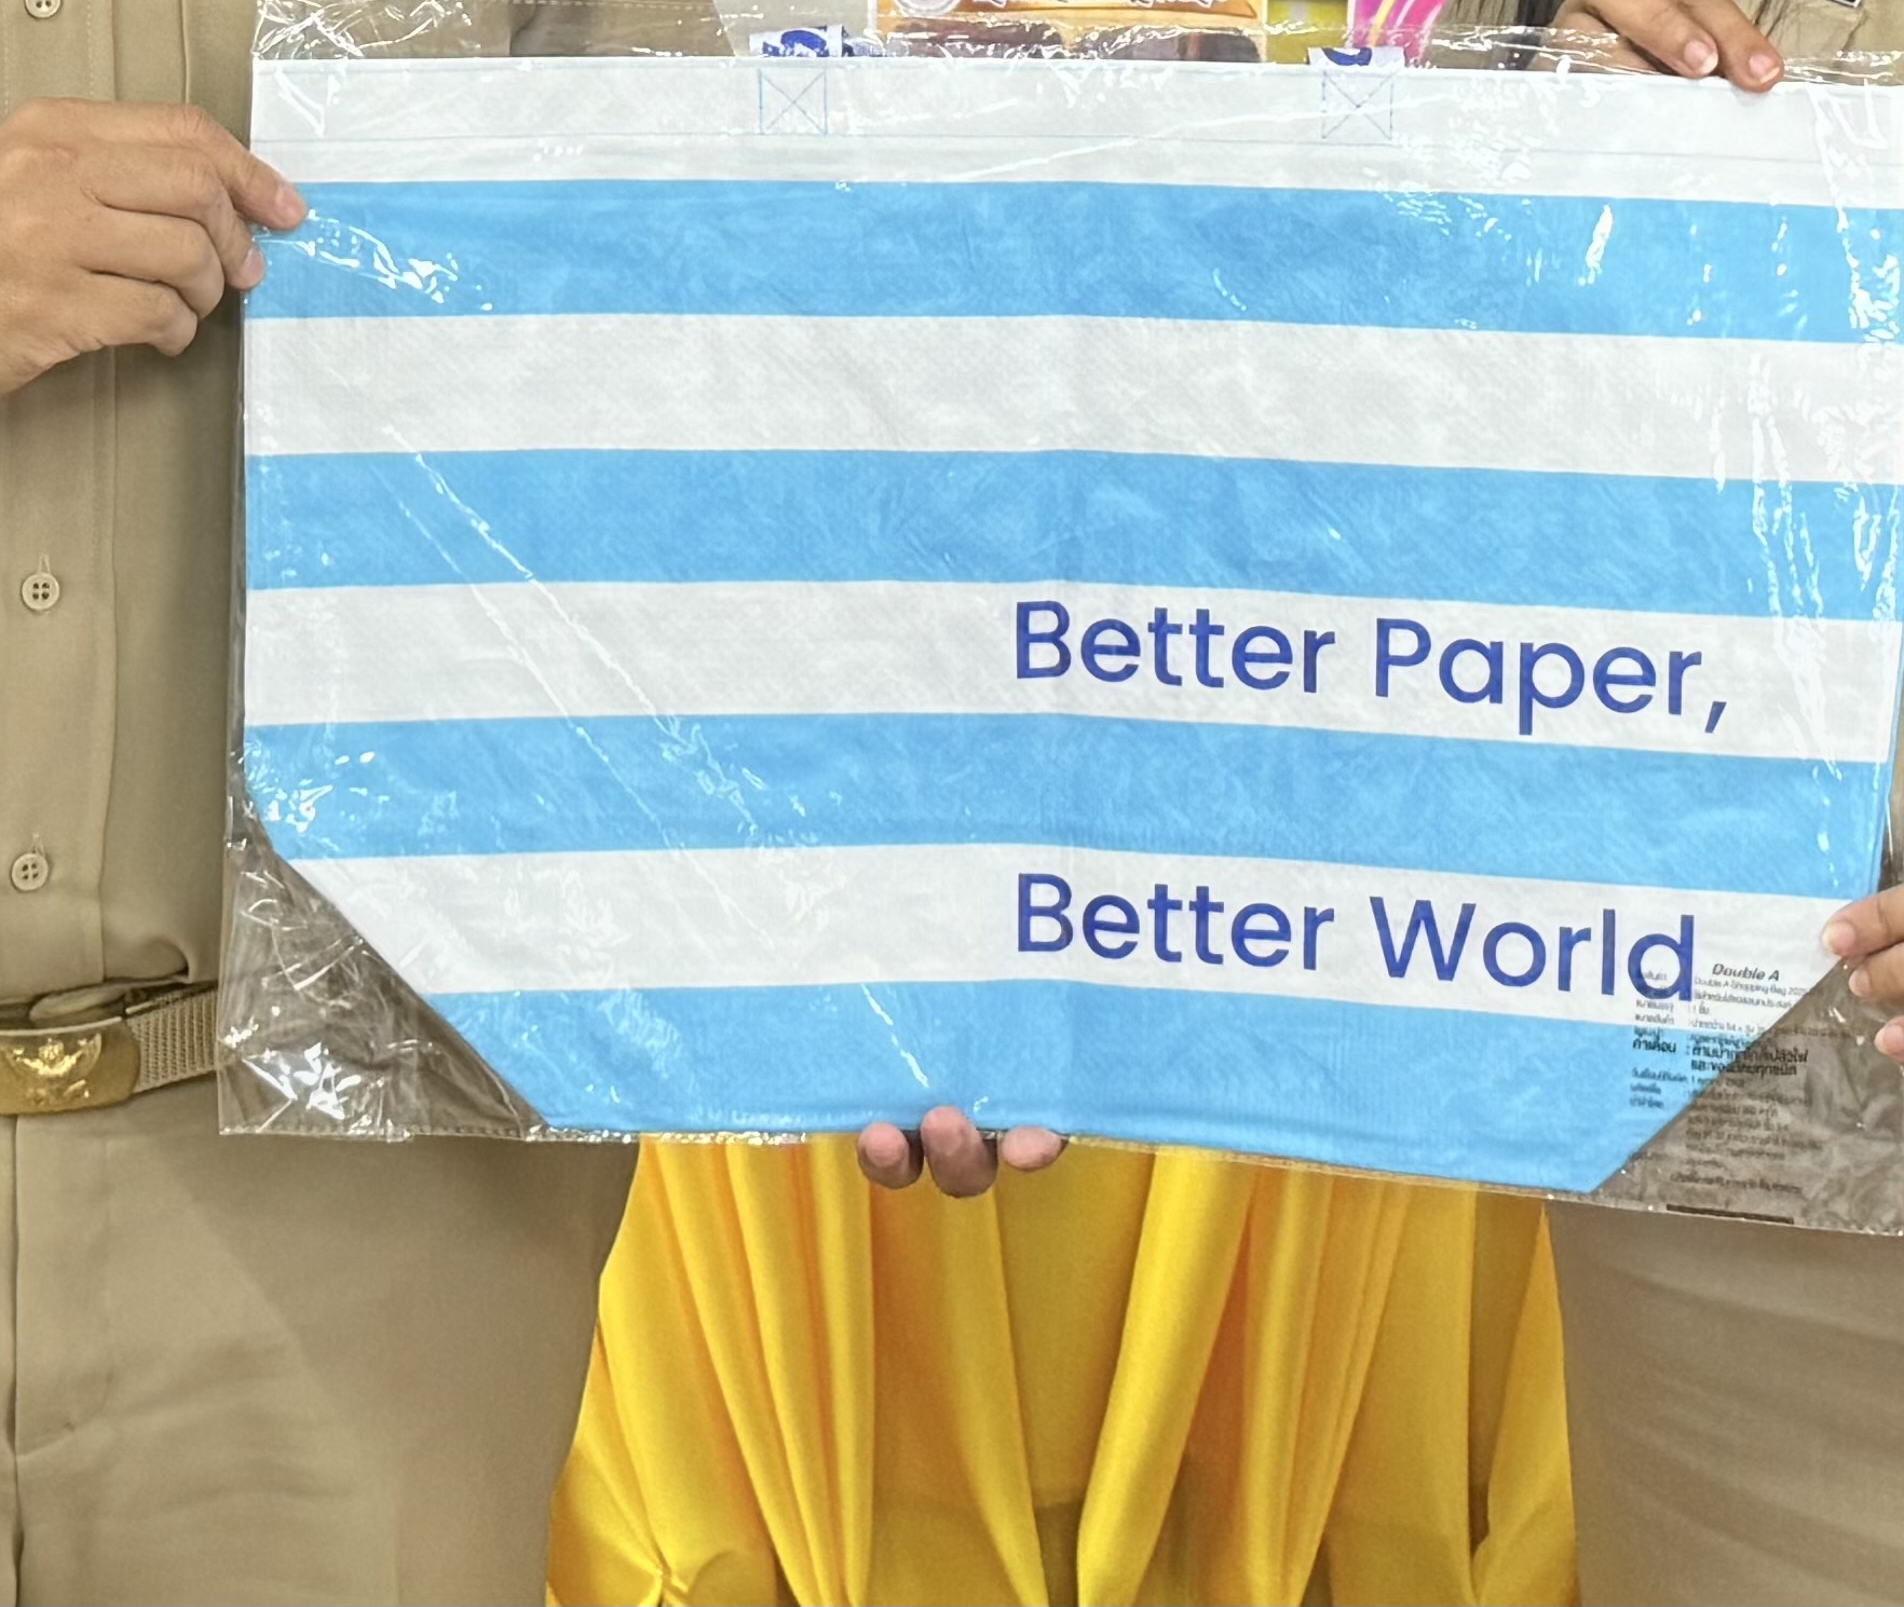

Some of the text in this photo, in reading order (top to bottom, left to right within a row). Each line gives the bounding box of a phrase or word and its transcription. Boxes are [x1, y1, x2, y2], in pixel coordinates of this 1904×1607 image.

[1014, 599, 1730, 737] Better Paper,
[1016, 872, 1696, 1003] Better World
[1712, 963, 1781, 983] Double A
